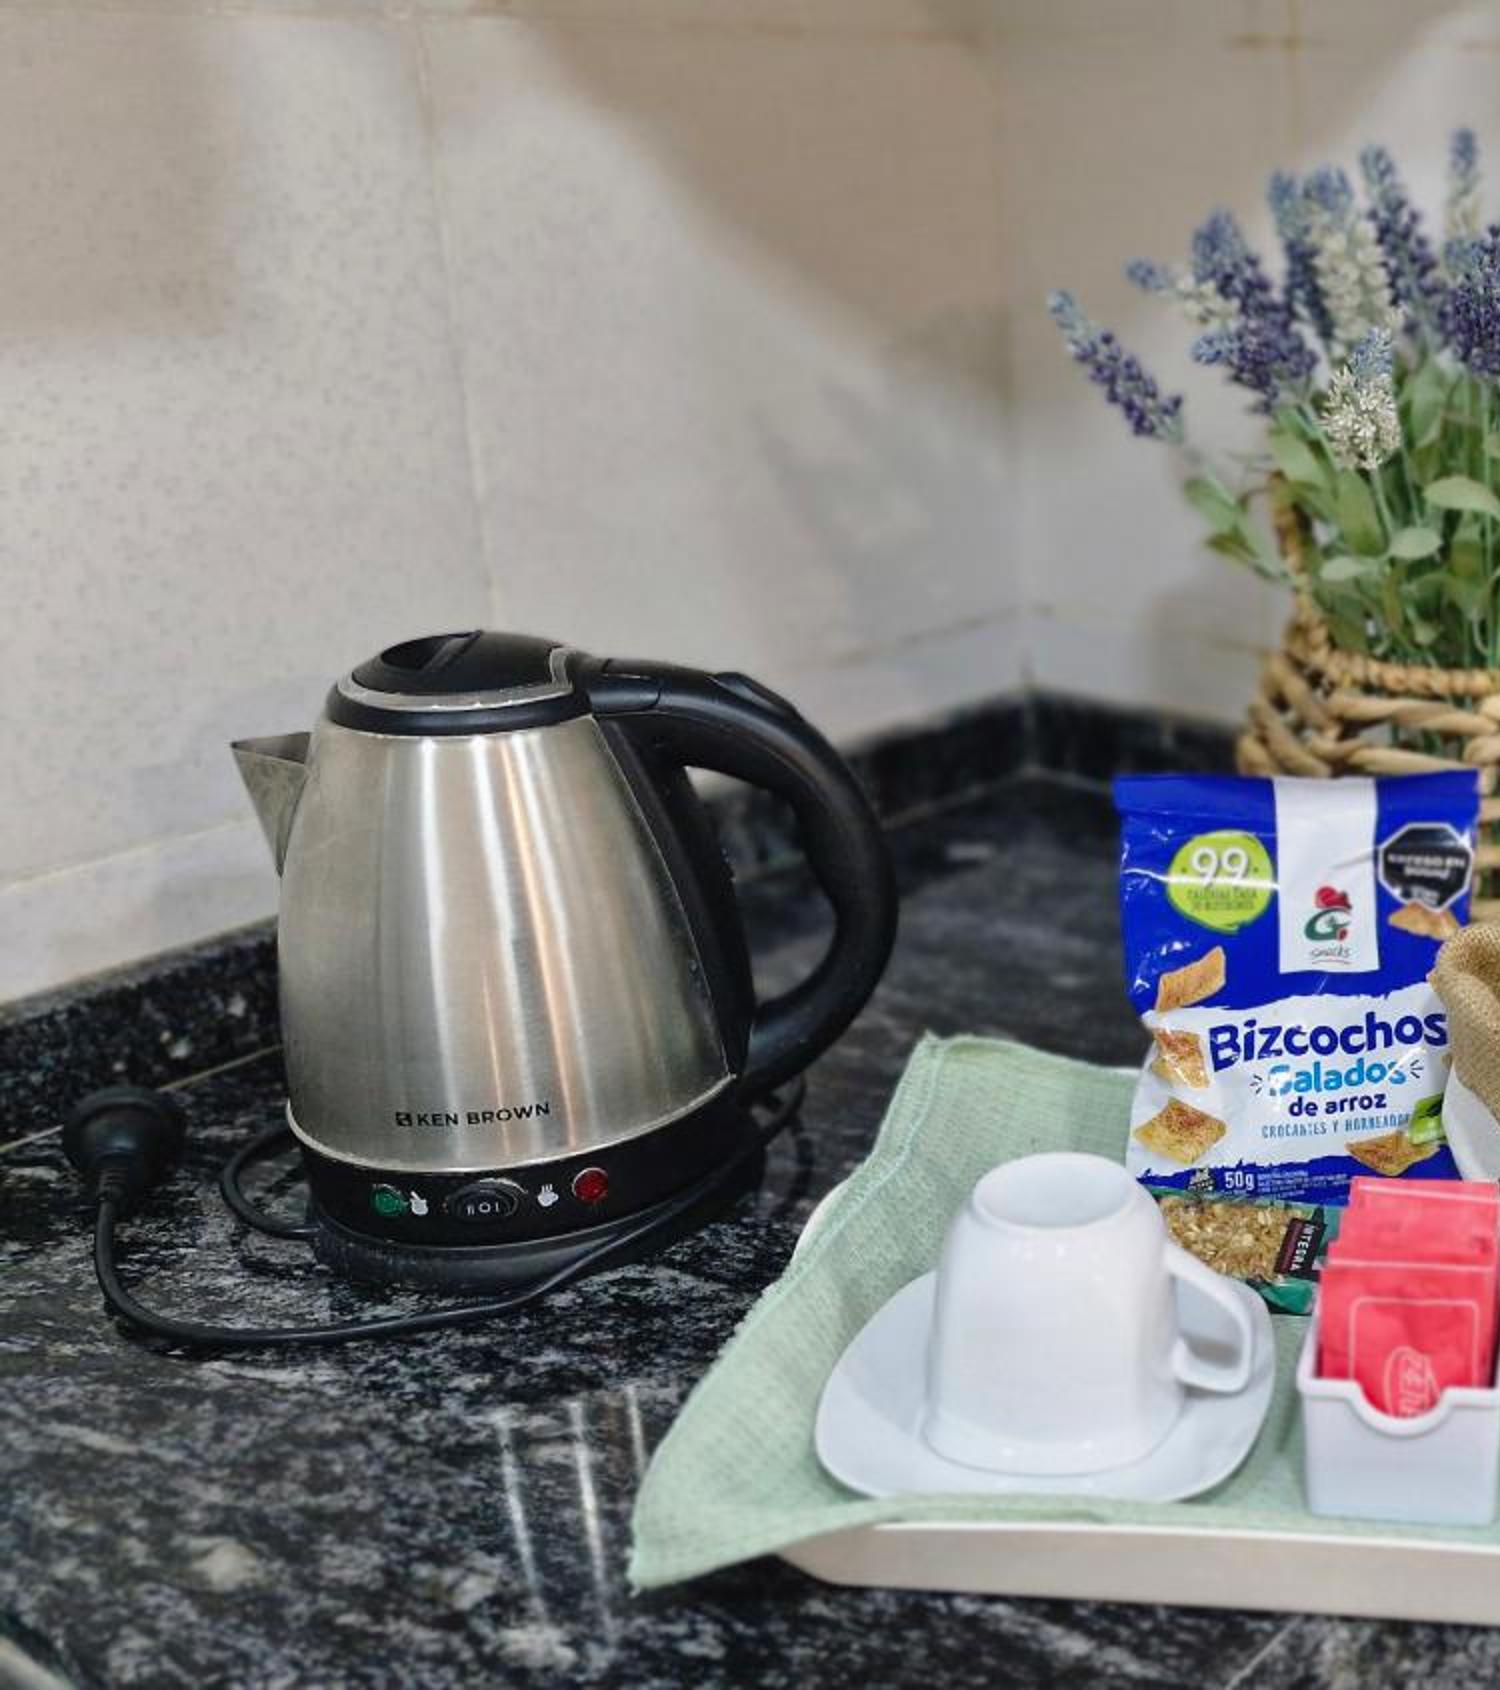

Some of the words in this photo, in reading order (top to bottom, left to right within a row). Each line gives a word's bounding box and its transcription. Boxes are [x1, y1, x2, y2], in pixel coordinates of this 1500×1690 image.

[1191, 847, 1248, 887] 99
[1209, 1011, 1448, 1072] Bizcochos
[1268, 1058, 1407, 1096] Salados
[417, 1112, 459, 1127] KEN
[467, 1102, 551, 1126] BROWN
[1289, 1096, 1318, 1116] de
[1324, 1093, 1387, 1114] arroz
[1332, 1119, 1340, 1133] Y
